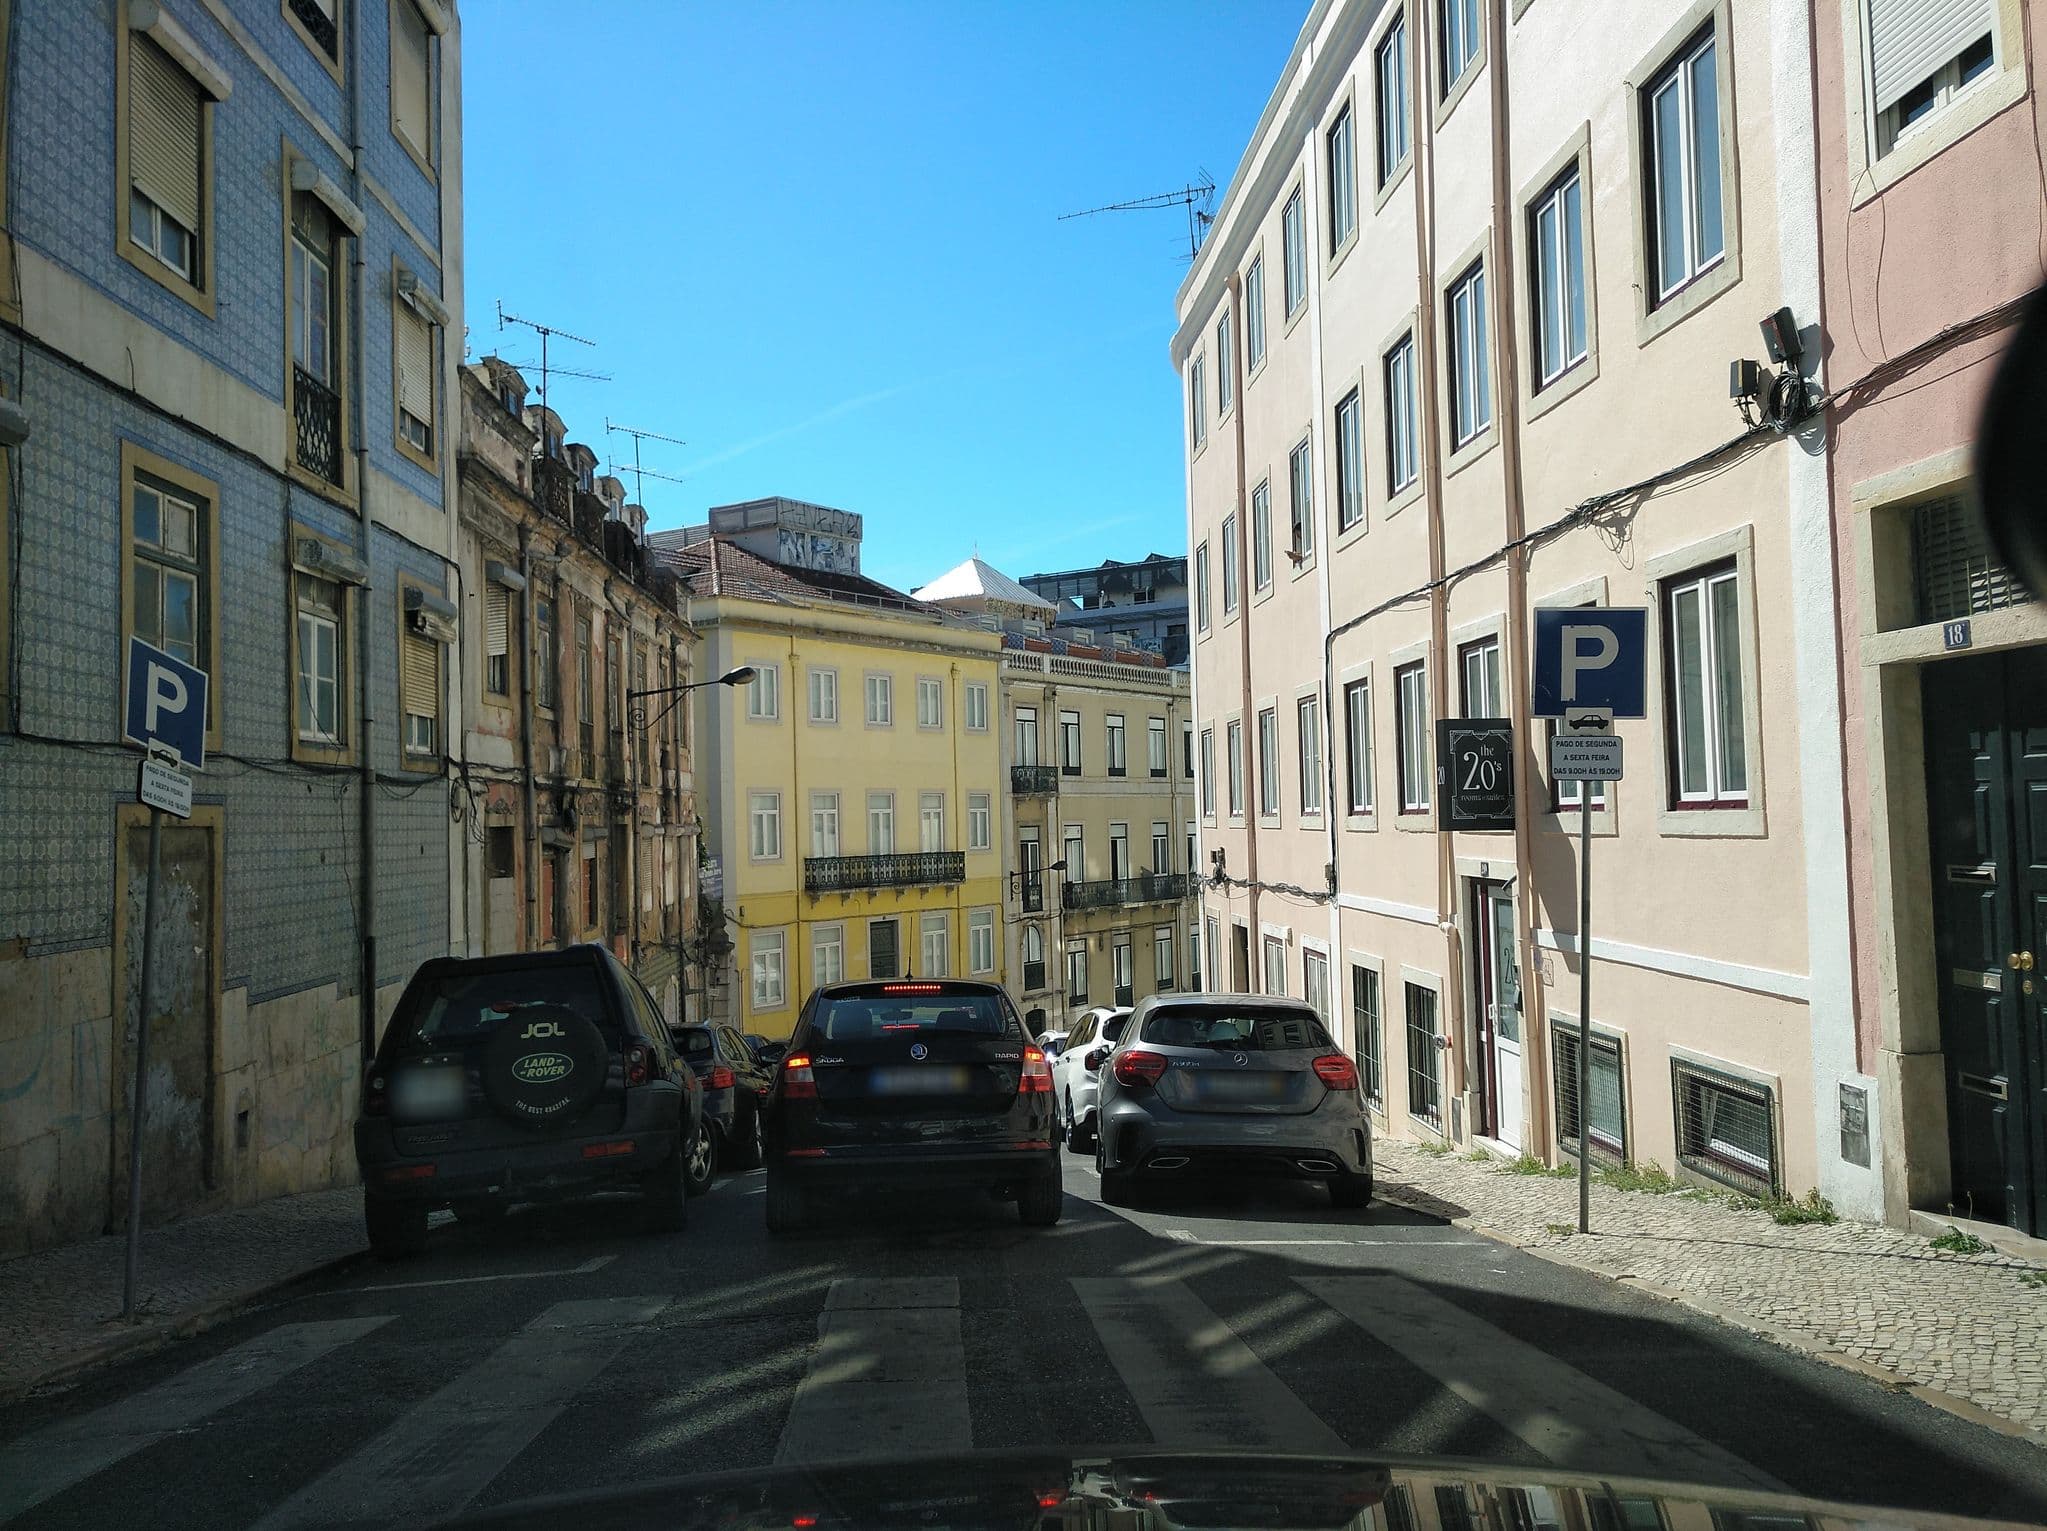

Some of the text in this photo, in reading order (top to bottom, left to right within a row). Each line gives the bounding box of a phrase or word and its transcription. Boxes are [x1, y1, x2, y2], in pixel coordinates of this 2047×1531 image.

[1948, 624, 1963, 645] 18
[1561, 625, 1619, 702] P
[146, 660, 188, 733] P
[1481, 745, 1495, 756] the
[520, 1022, 565, 1039] JOL
